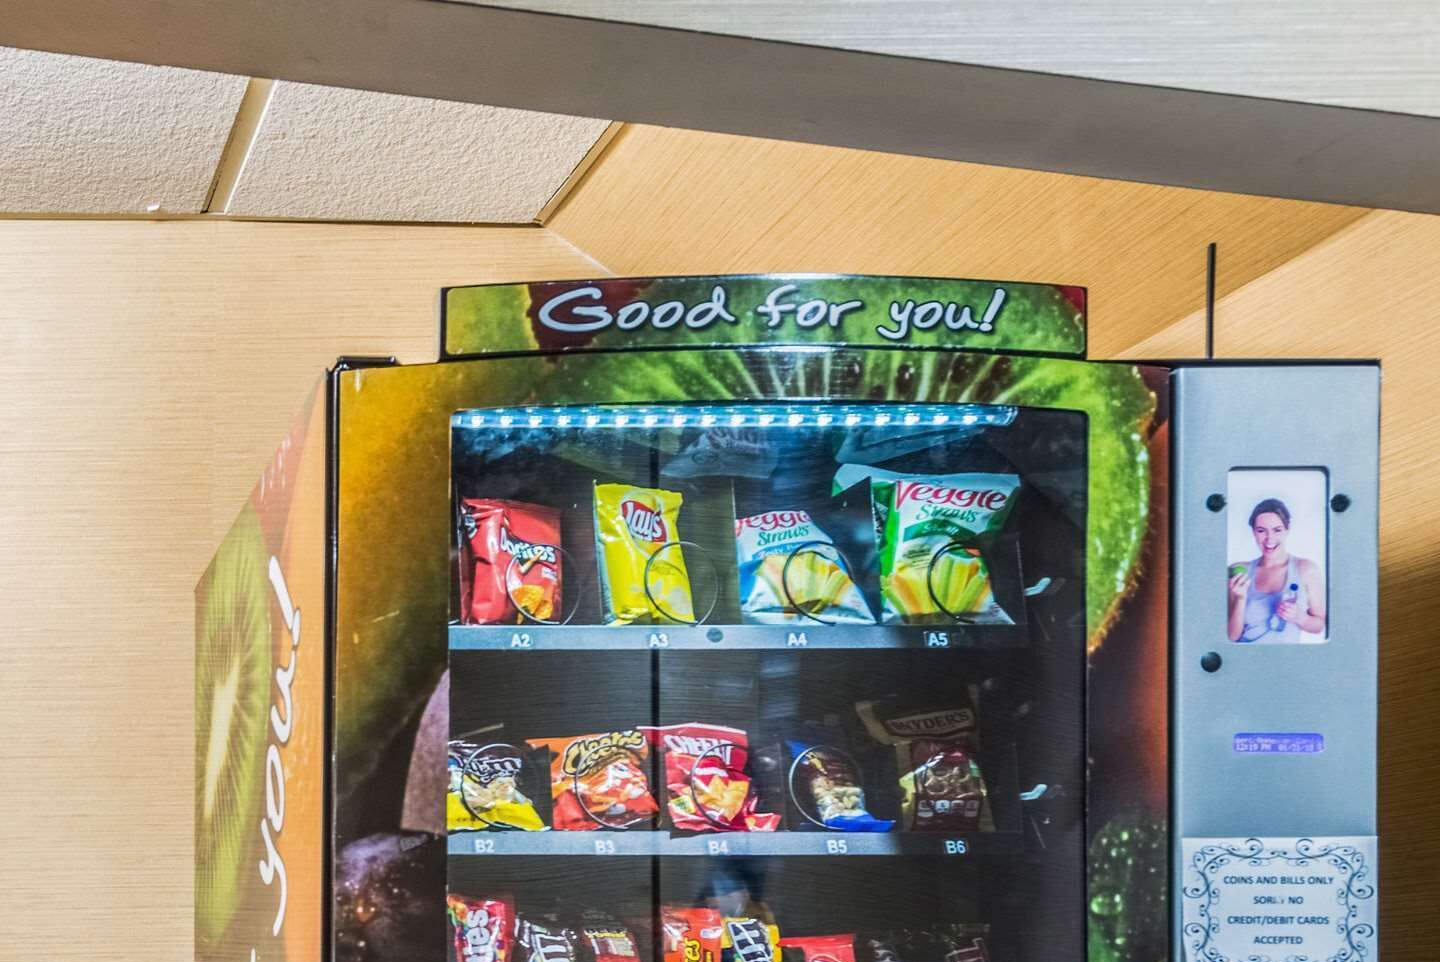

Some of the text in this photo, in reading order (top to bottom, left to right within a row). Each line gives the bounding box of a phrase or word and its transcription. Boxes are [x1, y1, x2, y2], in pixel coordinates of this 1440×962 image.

[538, 284, 1007, 340] Good for you!
[895, 480, 1008, 512] Veggie
[915, 503, 979, 524] Straws
[757, 525, 810, 547] Straws
[500, 526, 557, 564] Doritos
[511, 633, 531, 648] A2
[649, 633, 669, 648] A3
[787, 632, 808, 647] A4
[927, 632, 949, 647] A5
[258, 555, 301, 936] you!
[563, 730, 646, 776] Cheetos
[474, 840, 495, 854] B2
[595, 840, 615, 854] B3
[708, 840, 728, 854] B4
[826, 839, 847, 854] B5
[946, 840, 966, 854] B6
[1223, 876, 1334, 885] COINS AND BILLS ONLY
[1288, 896, 1304, 905] NO
[1227, 916, 1330, 926] CREDIT/DEBIT CARDS
[1253, 936, 1304, 945] ACCEPTED
